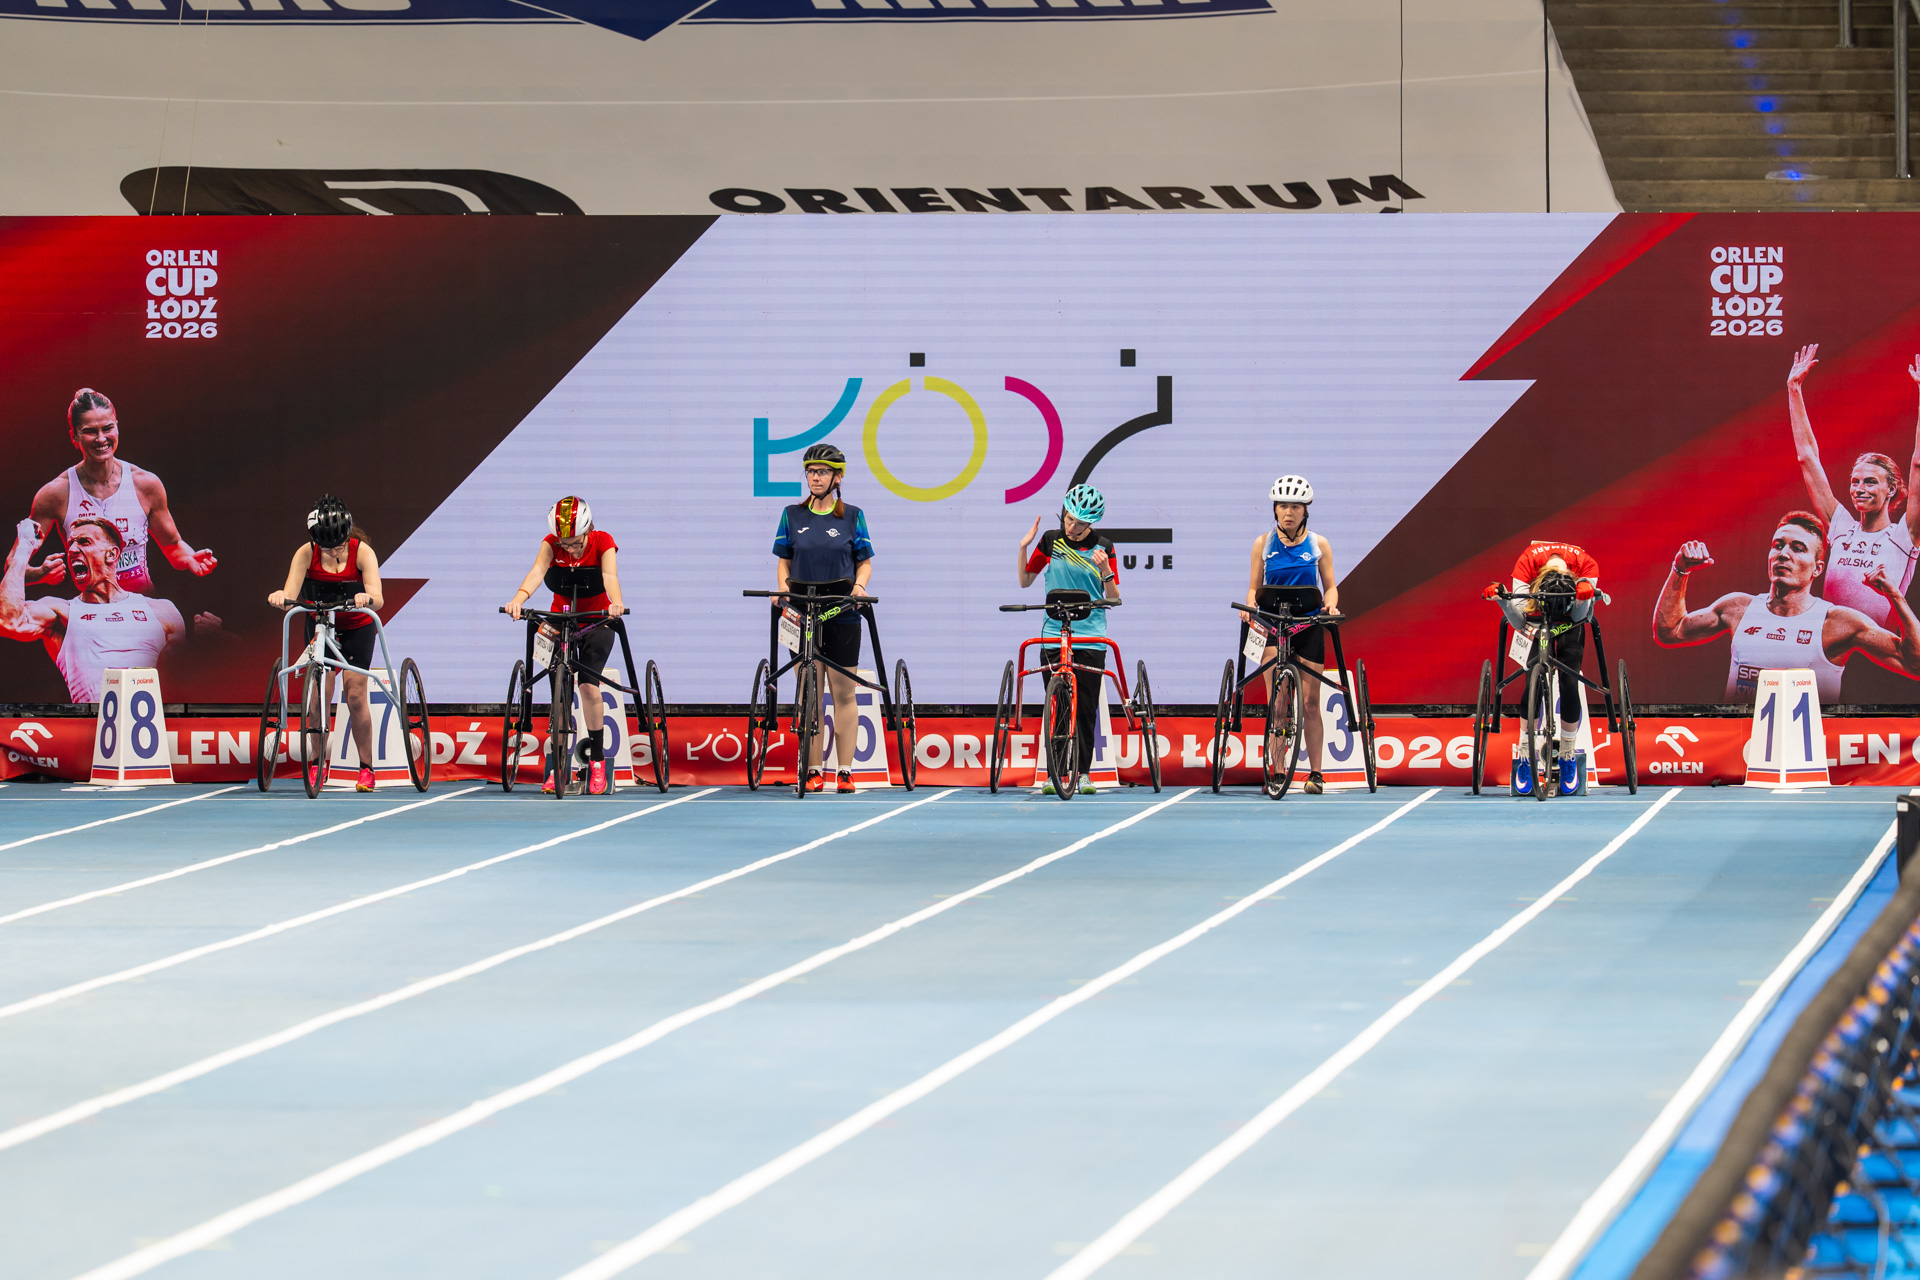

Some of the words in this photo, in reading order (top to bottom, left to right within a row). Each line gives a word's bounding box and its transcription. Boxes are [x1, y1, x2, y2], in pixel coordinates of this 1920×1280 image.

[708, 174, 1426, 214] ORIENTARIUM
[145, 249, 218, 266] ORLEN
[1710, 246, 1783, 263] ORLEN
[145, 267, 218, 296] CUP
[1710, 264, 1784, 293] CUP
[146, 297, 218, 319] ŁÓDŹ
[1711, 294, 1783, 316] ŁÓDŹ
[145, 321, 218, 338] 2026
[1710, 319, 1783, 336] 2026
[1123, 555, 1173, 570] UJE
[1836, 557, 1874, 568] POLSKA
[1739, 667, 1759, 680] SP
[100, 690, 118, 759] 8
[131, 690, 159, 760] 8
[370, 691, 394, 760] 7
[853, 692, 877, 762] 5
[1326, 692, 1355, 762] 3
[1760, 692, 1776, 762] 1
[1792, 691, 1813, 762] 1
[8, 751, 59, 769] ORLEN
[166, 731, 251, 764] LEN
[506, 733, 654, 767] 26
[916, 733, 1042, 769] ORLE
[1112, 734, 1171, 769] UP
[1372, 735, 1481, 769] 026
[1648, 761, 1704, 774] ORLEN
